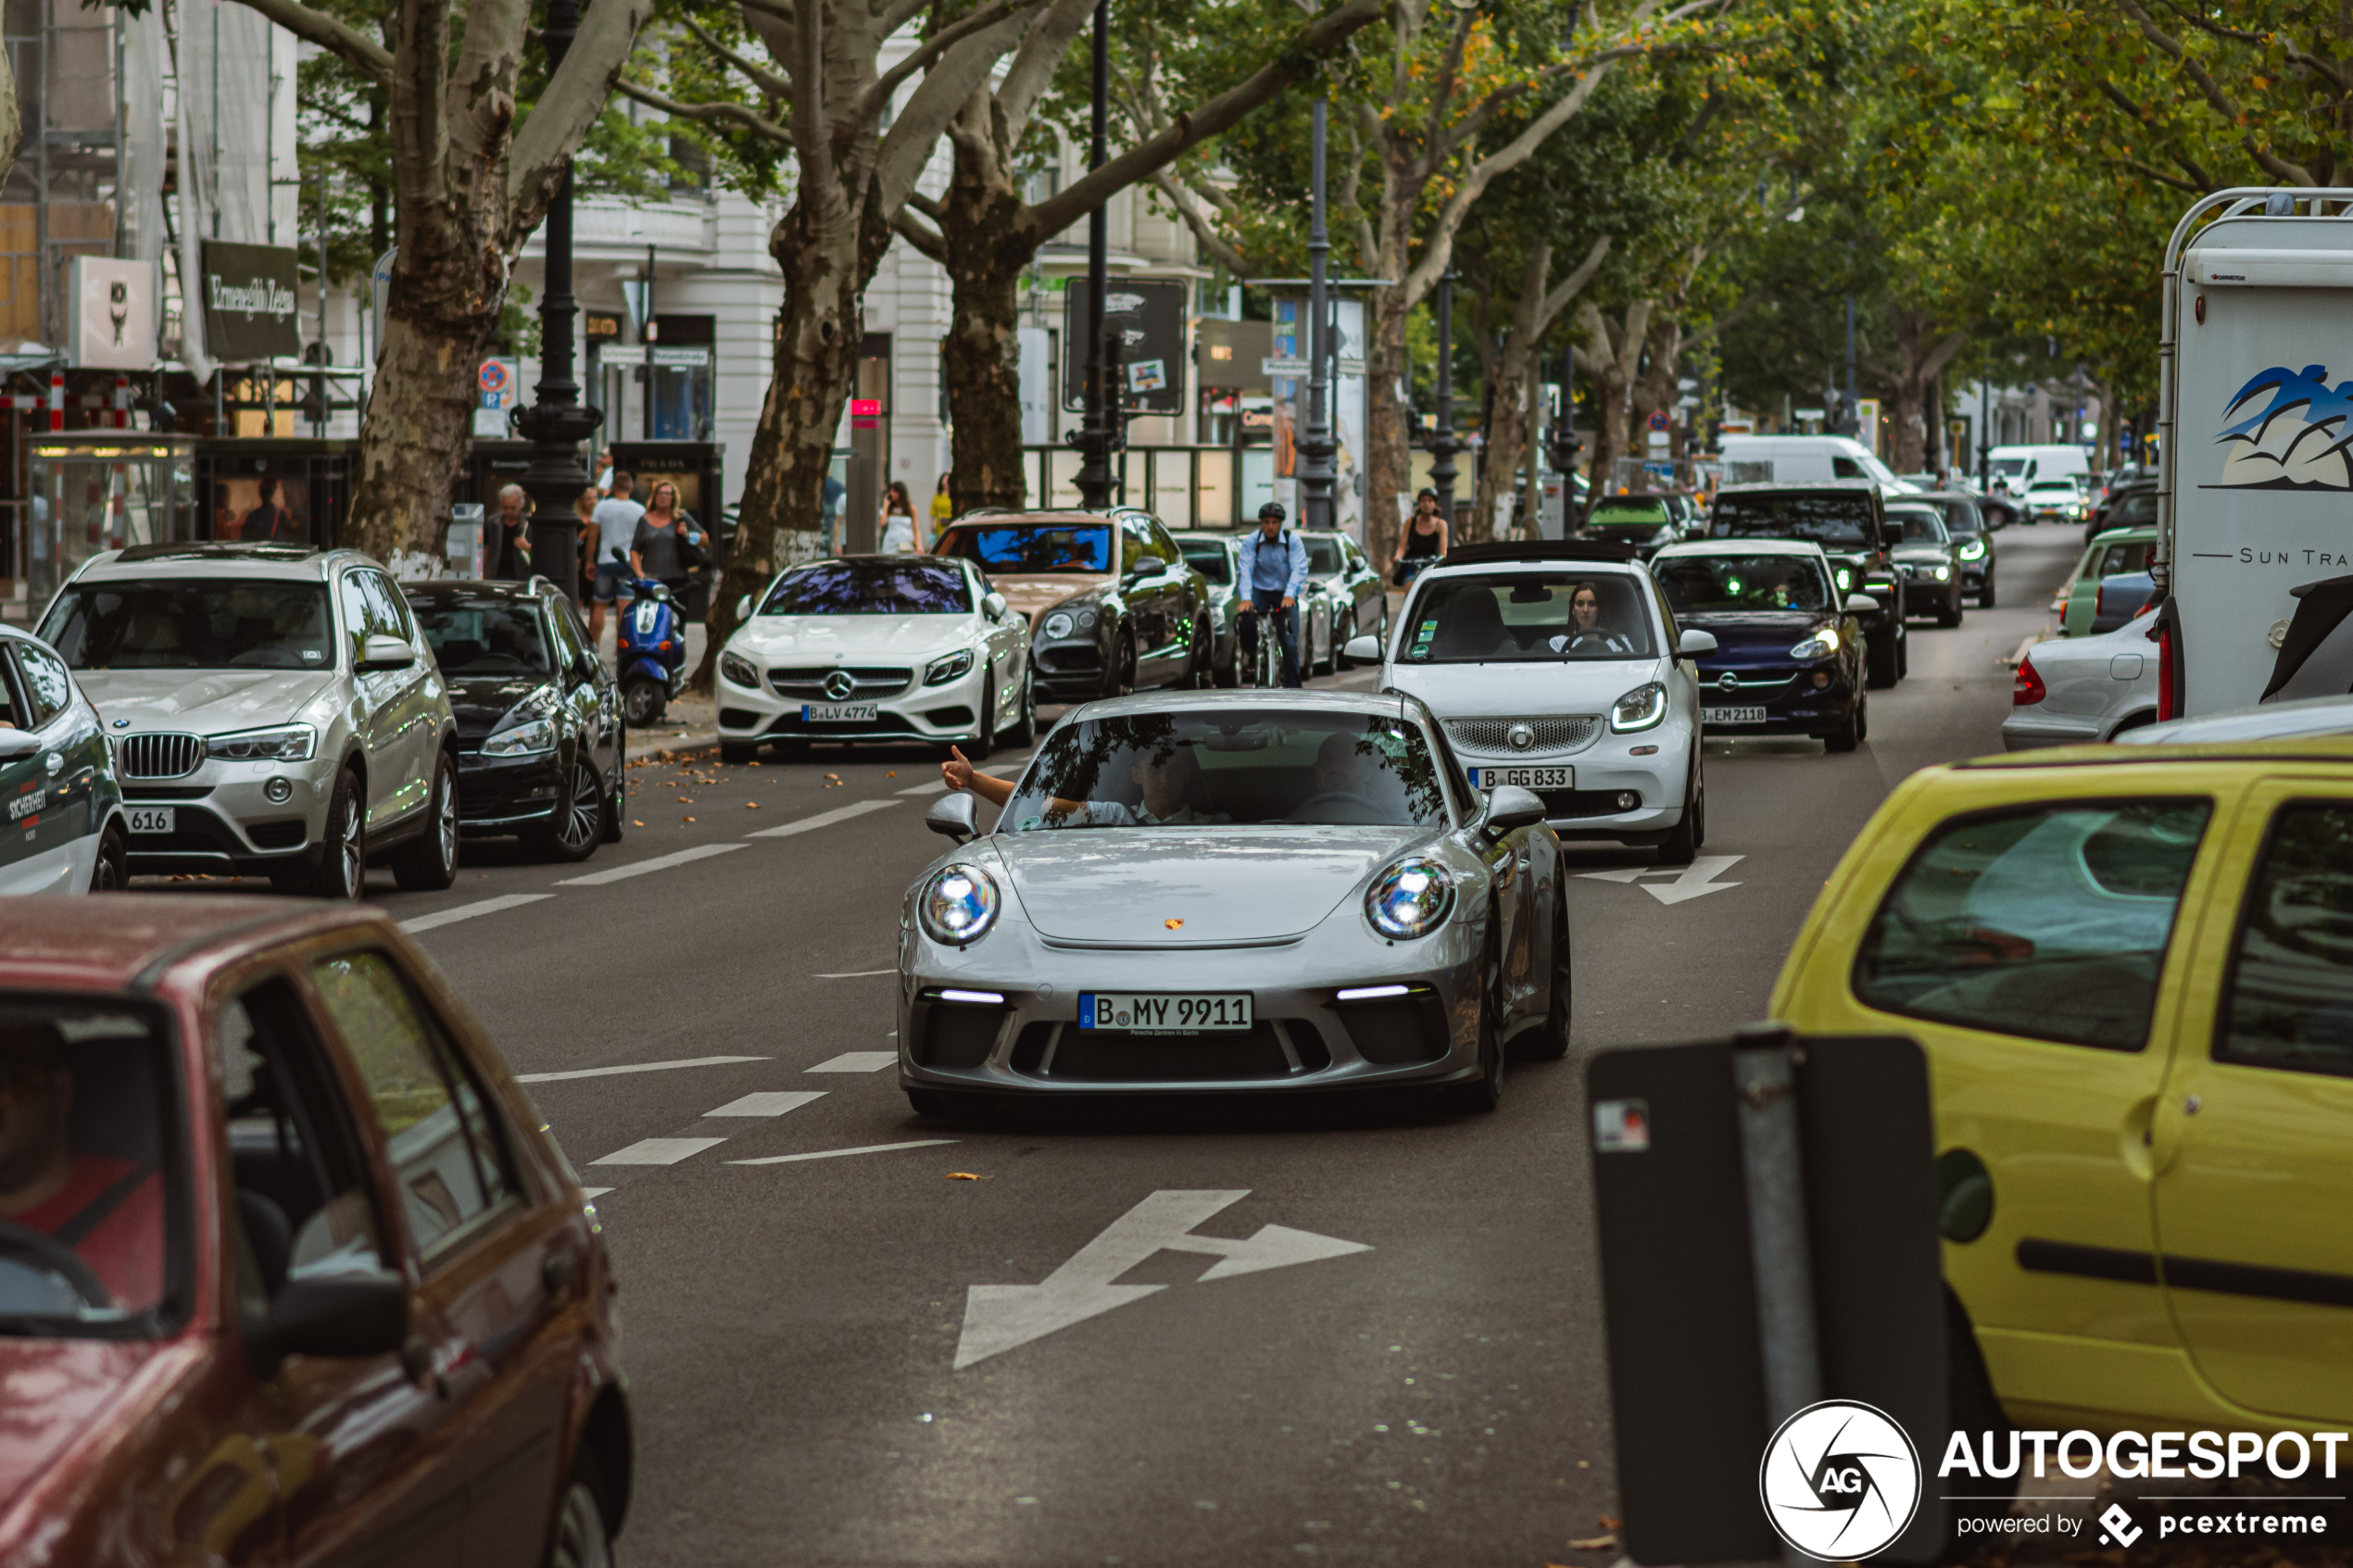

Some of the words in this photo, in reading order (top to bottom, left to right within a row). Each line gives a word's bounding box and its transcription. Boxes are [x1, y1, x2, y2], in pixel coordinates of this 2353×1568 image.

[210, 275, 268, 321] Ermenegildo
[268, 279, 295, 323] Zegna
[2303, 550, 2353, 566] TRA
[810, 708, 817, 719] B
[825, 708, 841, 719] LV
[844, 708, 875, 719] 4774
[1715, 709, 1731, 721] EM
[1734, 709, 1764, 721] 2118
[1485, 771, 1496, 786] B
[1507, 770, 1530, 785] GG
[1534, 769, 1566, 785] 833
[9, 789, 45, 821] SICHERHEIT
[132, 812, 166, 830] 616
[1097, 998, 1114, 1024] B
[1134, 998, 1170, 1025] MY
[1177, 998, 1248, 1025] 9911
